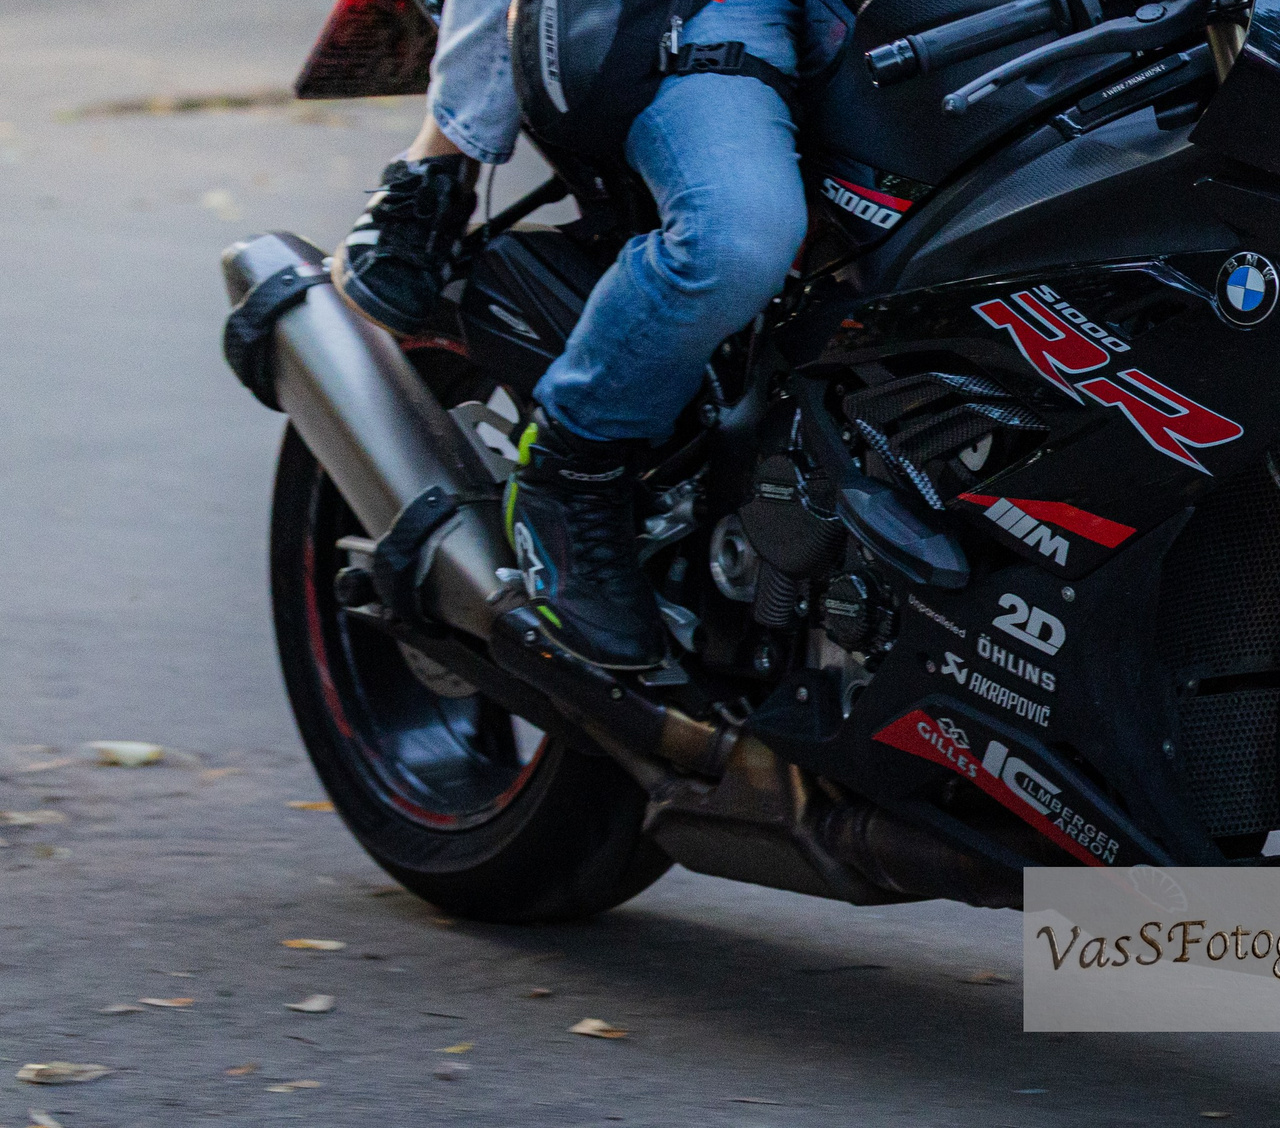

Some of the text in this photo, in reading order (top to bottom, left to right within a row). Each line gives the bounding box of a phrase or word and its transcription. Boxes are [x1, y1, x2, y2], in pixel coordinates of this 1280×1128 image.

[1225, 253, 1276, 281] BMW
[1032, 284, 1131, 352] S1000
[971, 290, 1244, 477] RR
[992, 593, 1066, 656] 2D
[977, 633, 1056, 692] ÖHLINS
[916, 722, 977, 778] GILLES
[1021, 777, 1120, 854] ILMBERGER
